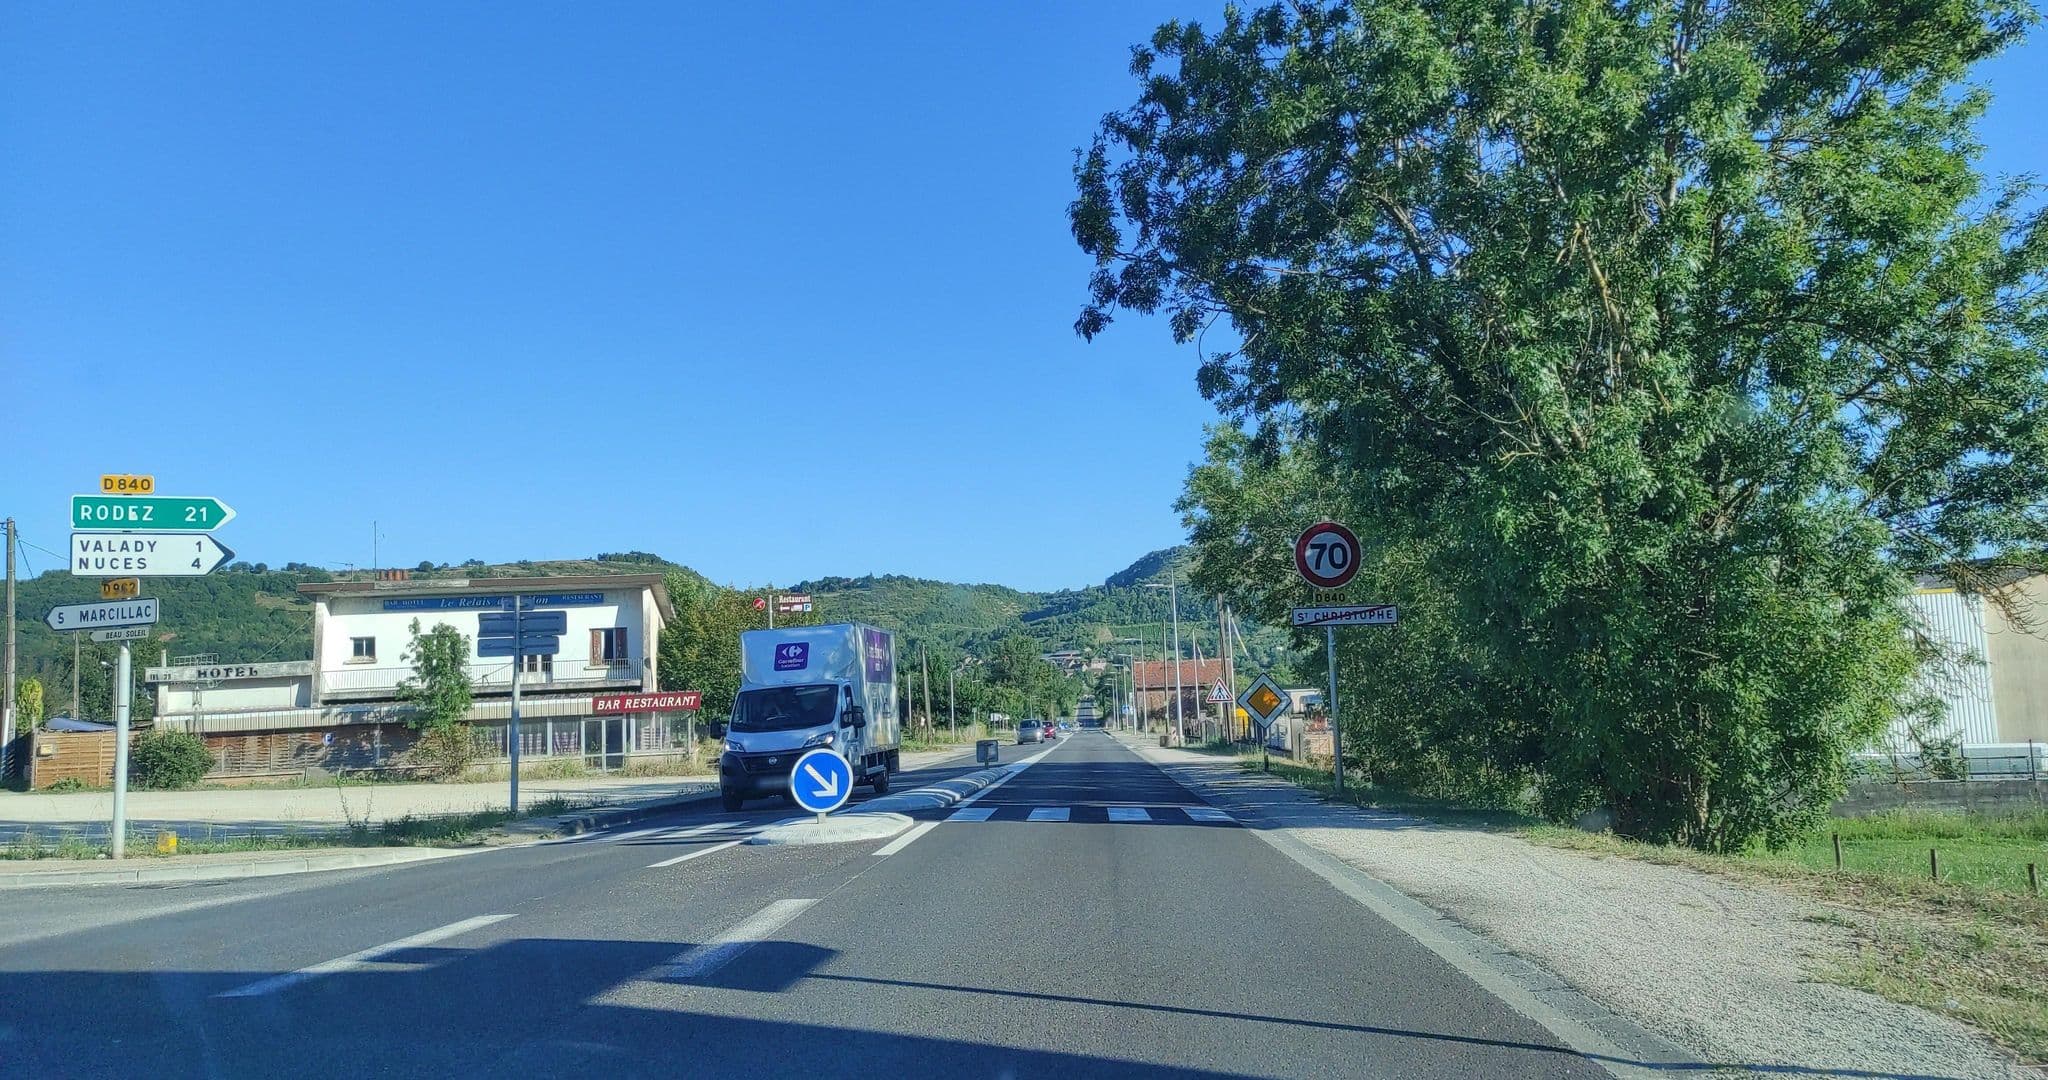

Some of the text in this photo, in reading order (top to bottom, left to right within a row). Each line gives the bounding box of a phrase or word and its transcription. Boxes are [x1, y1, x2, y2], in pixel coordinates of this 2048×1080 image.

[80, 505, 208, 522] RODEZ 21
[79, 540, 202, 553] VALADY 1
[1309, 542, 1348, 570] 70
[78, 557, 201, 570] NUCES 4
[440, 598, 454, 608] Le
[459, 597, 491, 607] Relais
[57, 605, 152, 624] 5 MARCILLAC
[1314, 609, 1393, 621] CHRISTOPHE
[105, 629, 147, 639] BEAU SOLEIL
[197, 667, 258, 679] HOTEL
[597, 696, 697, 710] BAR RESTAURANT
